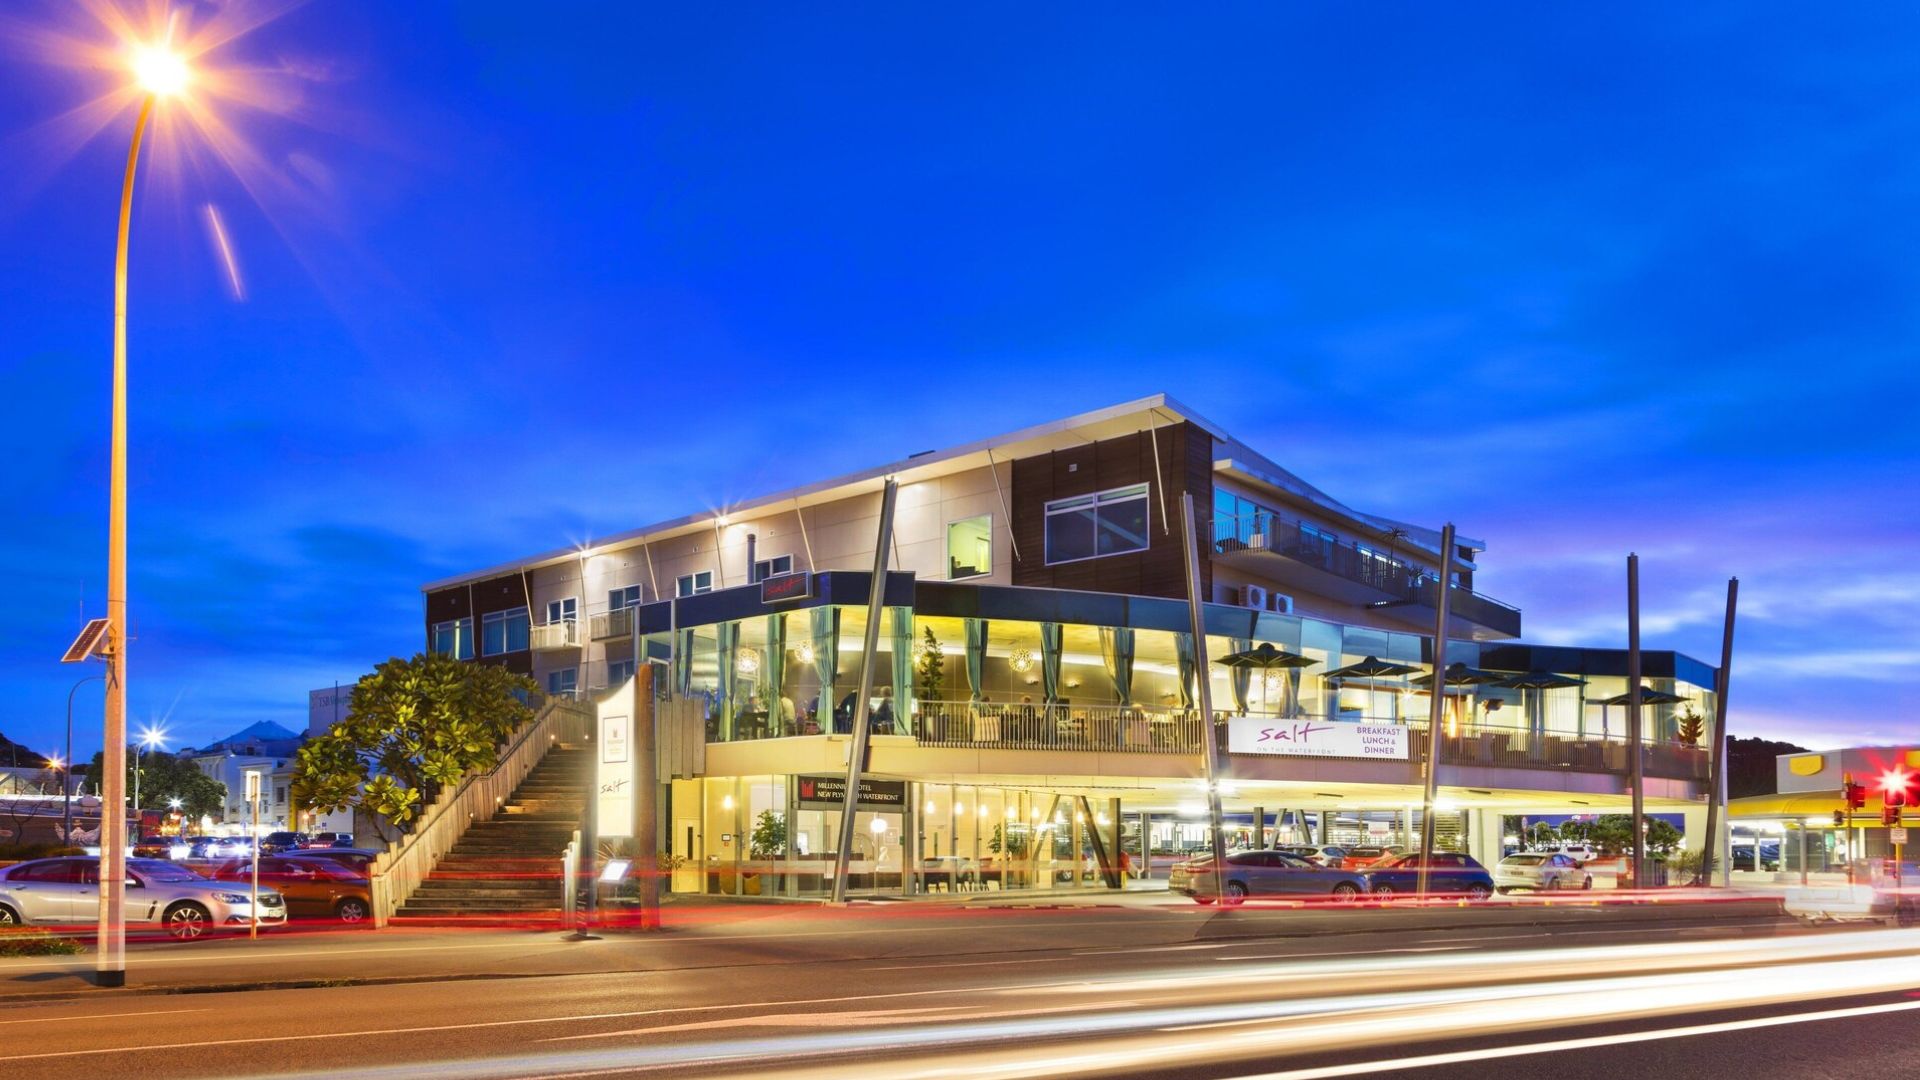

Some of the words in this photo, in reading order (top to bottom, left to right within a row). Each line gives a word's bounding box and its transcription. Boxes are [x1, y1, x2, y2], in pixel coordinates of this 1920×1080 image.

[1257, 722, 1335, 743] salt
[1357, 726, 1400, 735] BREAKFAST
[1362, 737, 1389, 745] LUNCH
[1364, 746, 1395, 754] DINNER
[600, 778, 630, 794] salt
[863, 793, 899, 801] WATERFRONT
